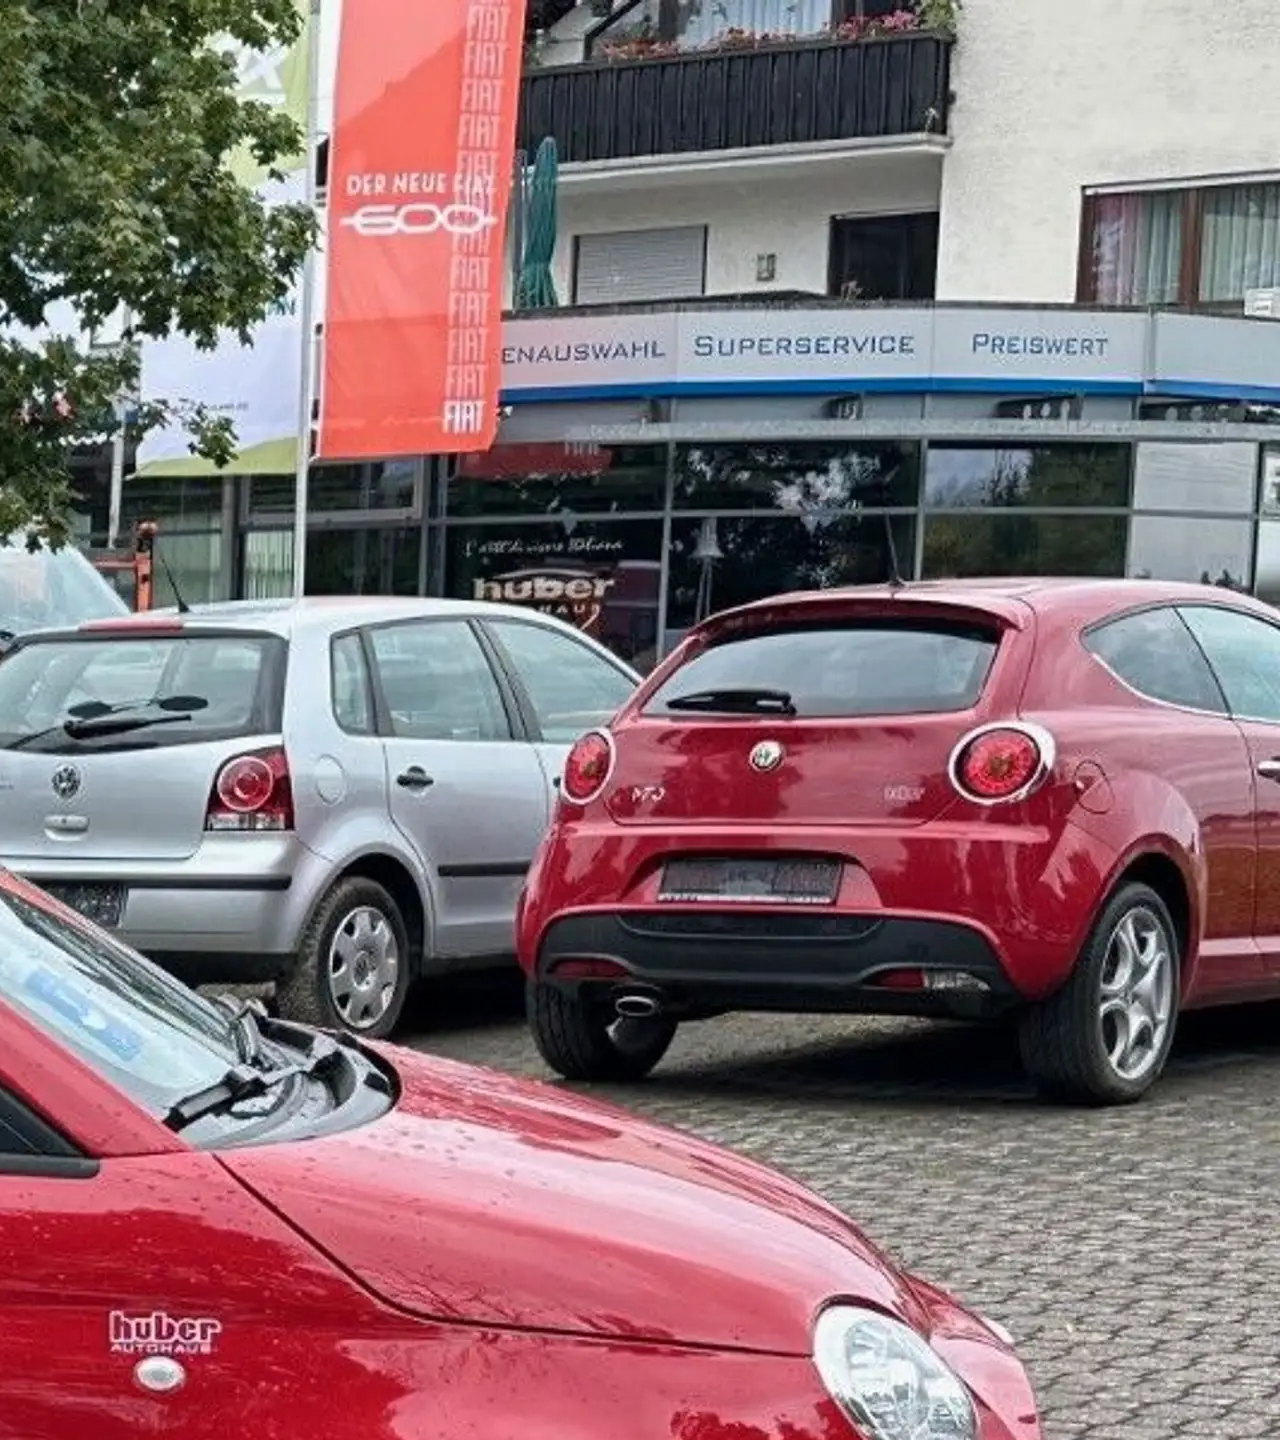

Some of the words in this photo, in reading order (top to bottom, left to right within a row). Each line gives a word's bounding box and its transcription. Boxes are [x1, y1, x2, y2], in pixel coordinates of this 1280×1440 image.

[463, 41, 507, 76] FIAT
[461, 78, 504, 112] FIAT
[458, 114, 501, 148] FIAT
[346, 173, 385, 195] DER
[392, 172, 446, 193] NEUE
[342, 204, 496, 235] 600
[450, 256, 492, 290] FIAT
[448, 292, 490, 326] FIAT
[447, 328, 489, 362] FIAT
[445, 364, 487, 398] FIAT
[443, 400, 486, 433] FIAT
[473, 576, 615, 600] huber
[108, 1310, 223, 1342] huber
